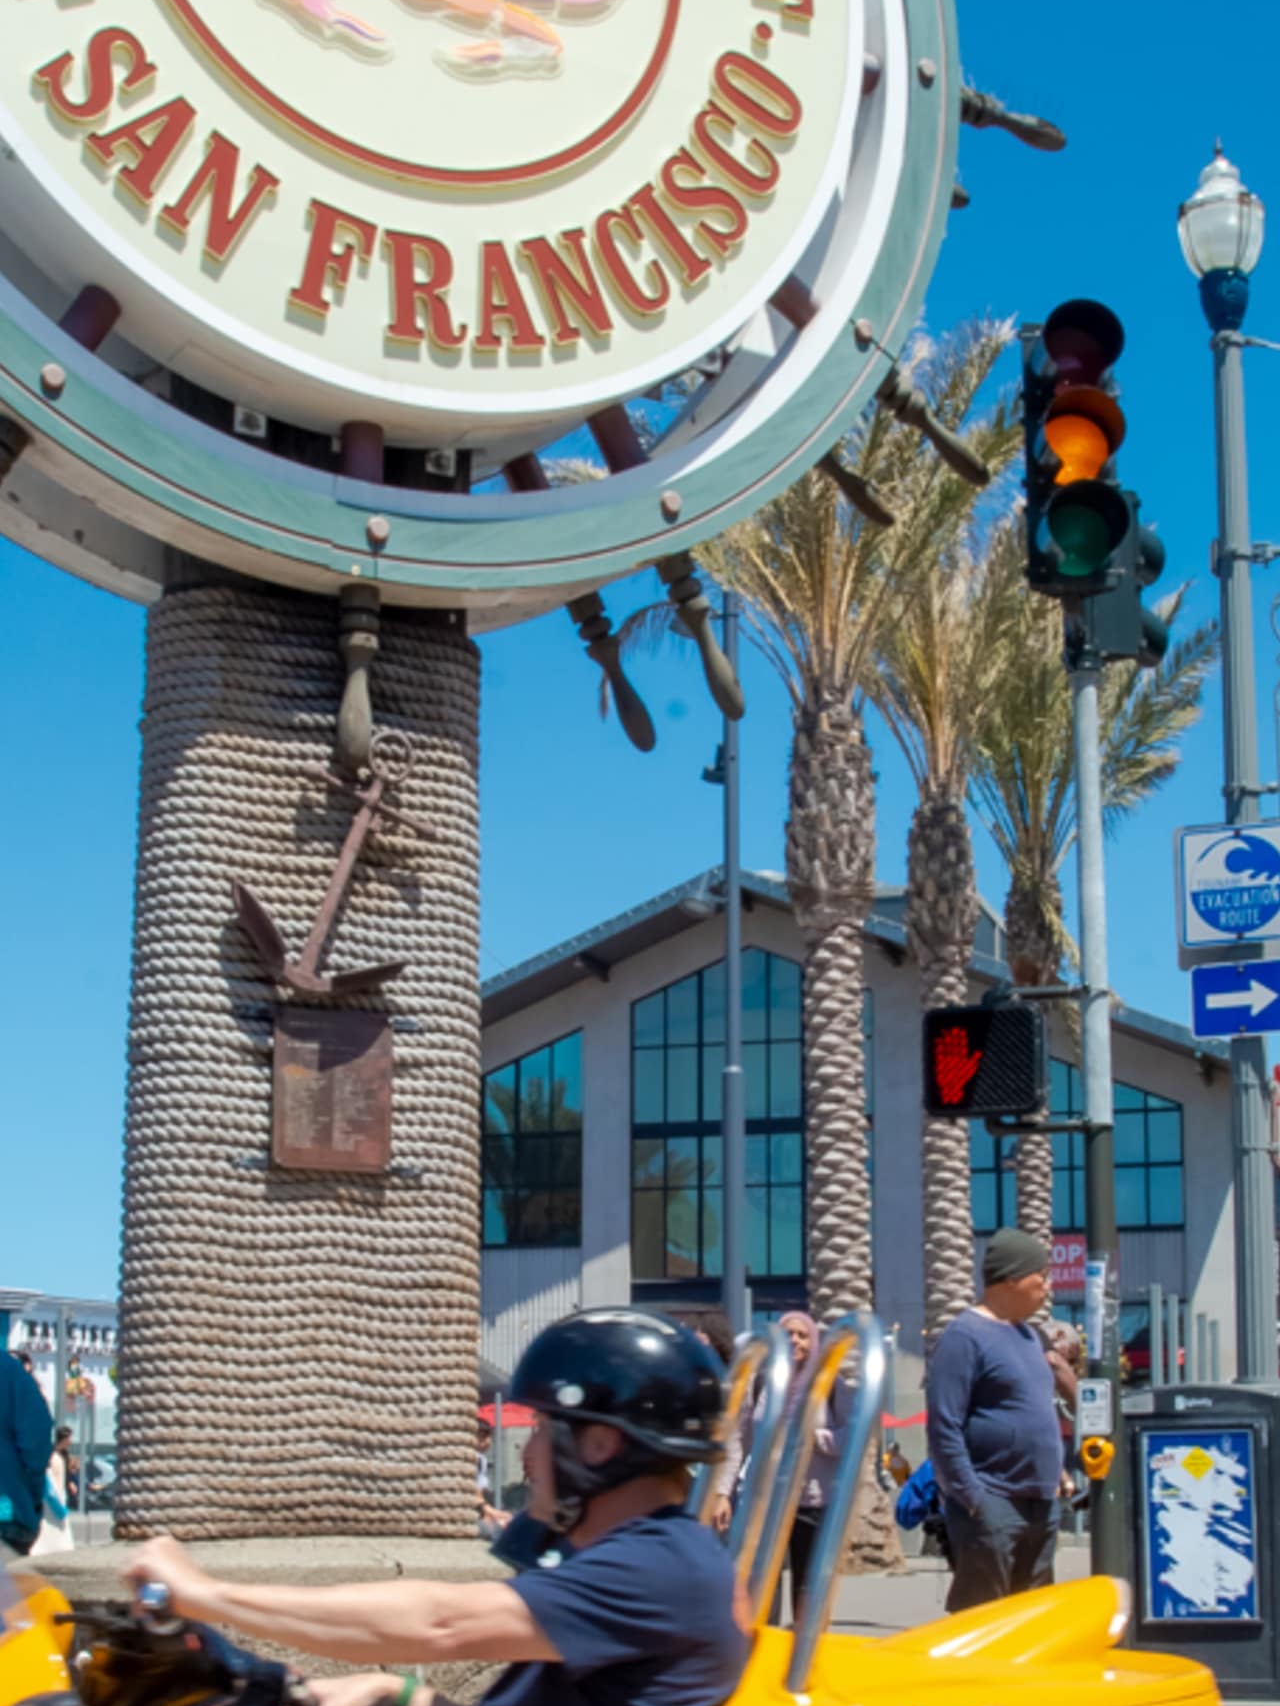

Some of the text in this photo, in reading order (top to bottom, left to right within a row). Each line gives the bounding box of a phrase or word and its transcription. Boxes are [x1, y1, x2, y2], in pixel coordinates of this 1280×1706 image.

[35, 27, 280, 265] SAN
[288, 47, 805, 351] FRANCISCO
[1198, 886, 1280, 911] EVACUATION
[1219, 908, 1261, 927] ROUTE
